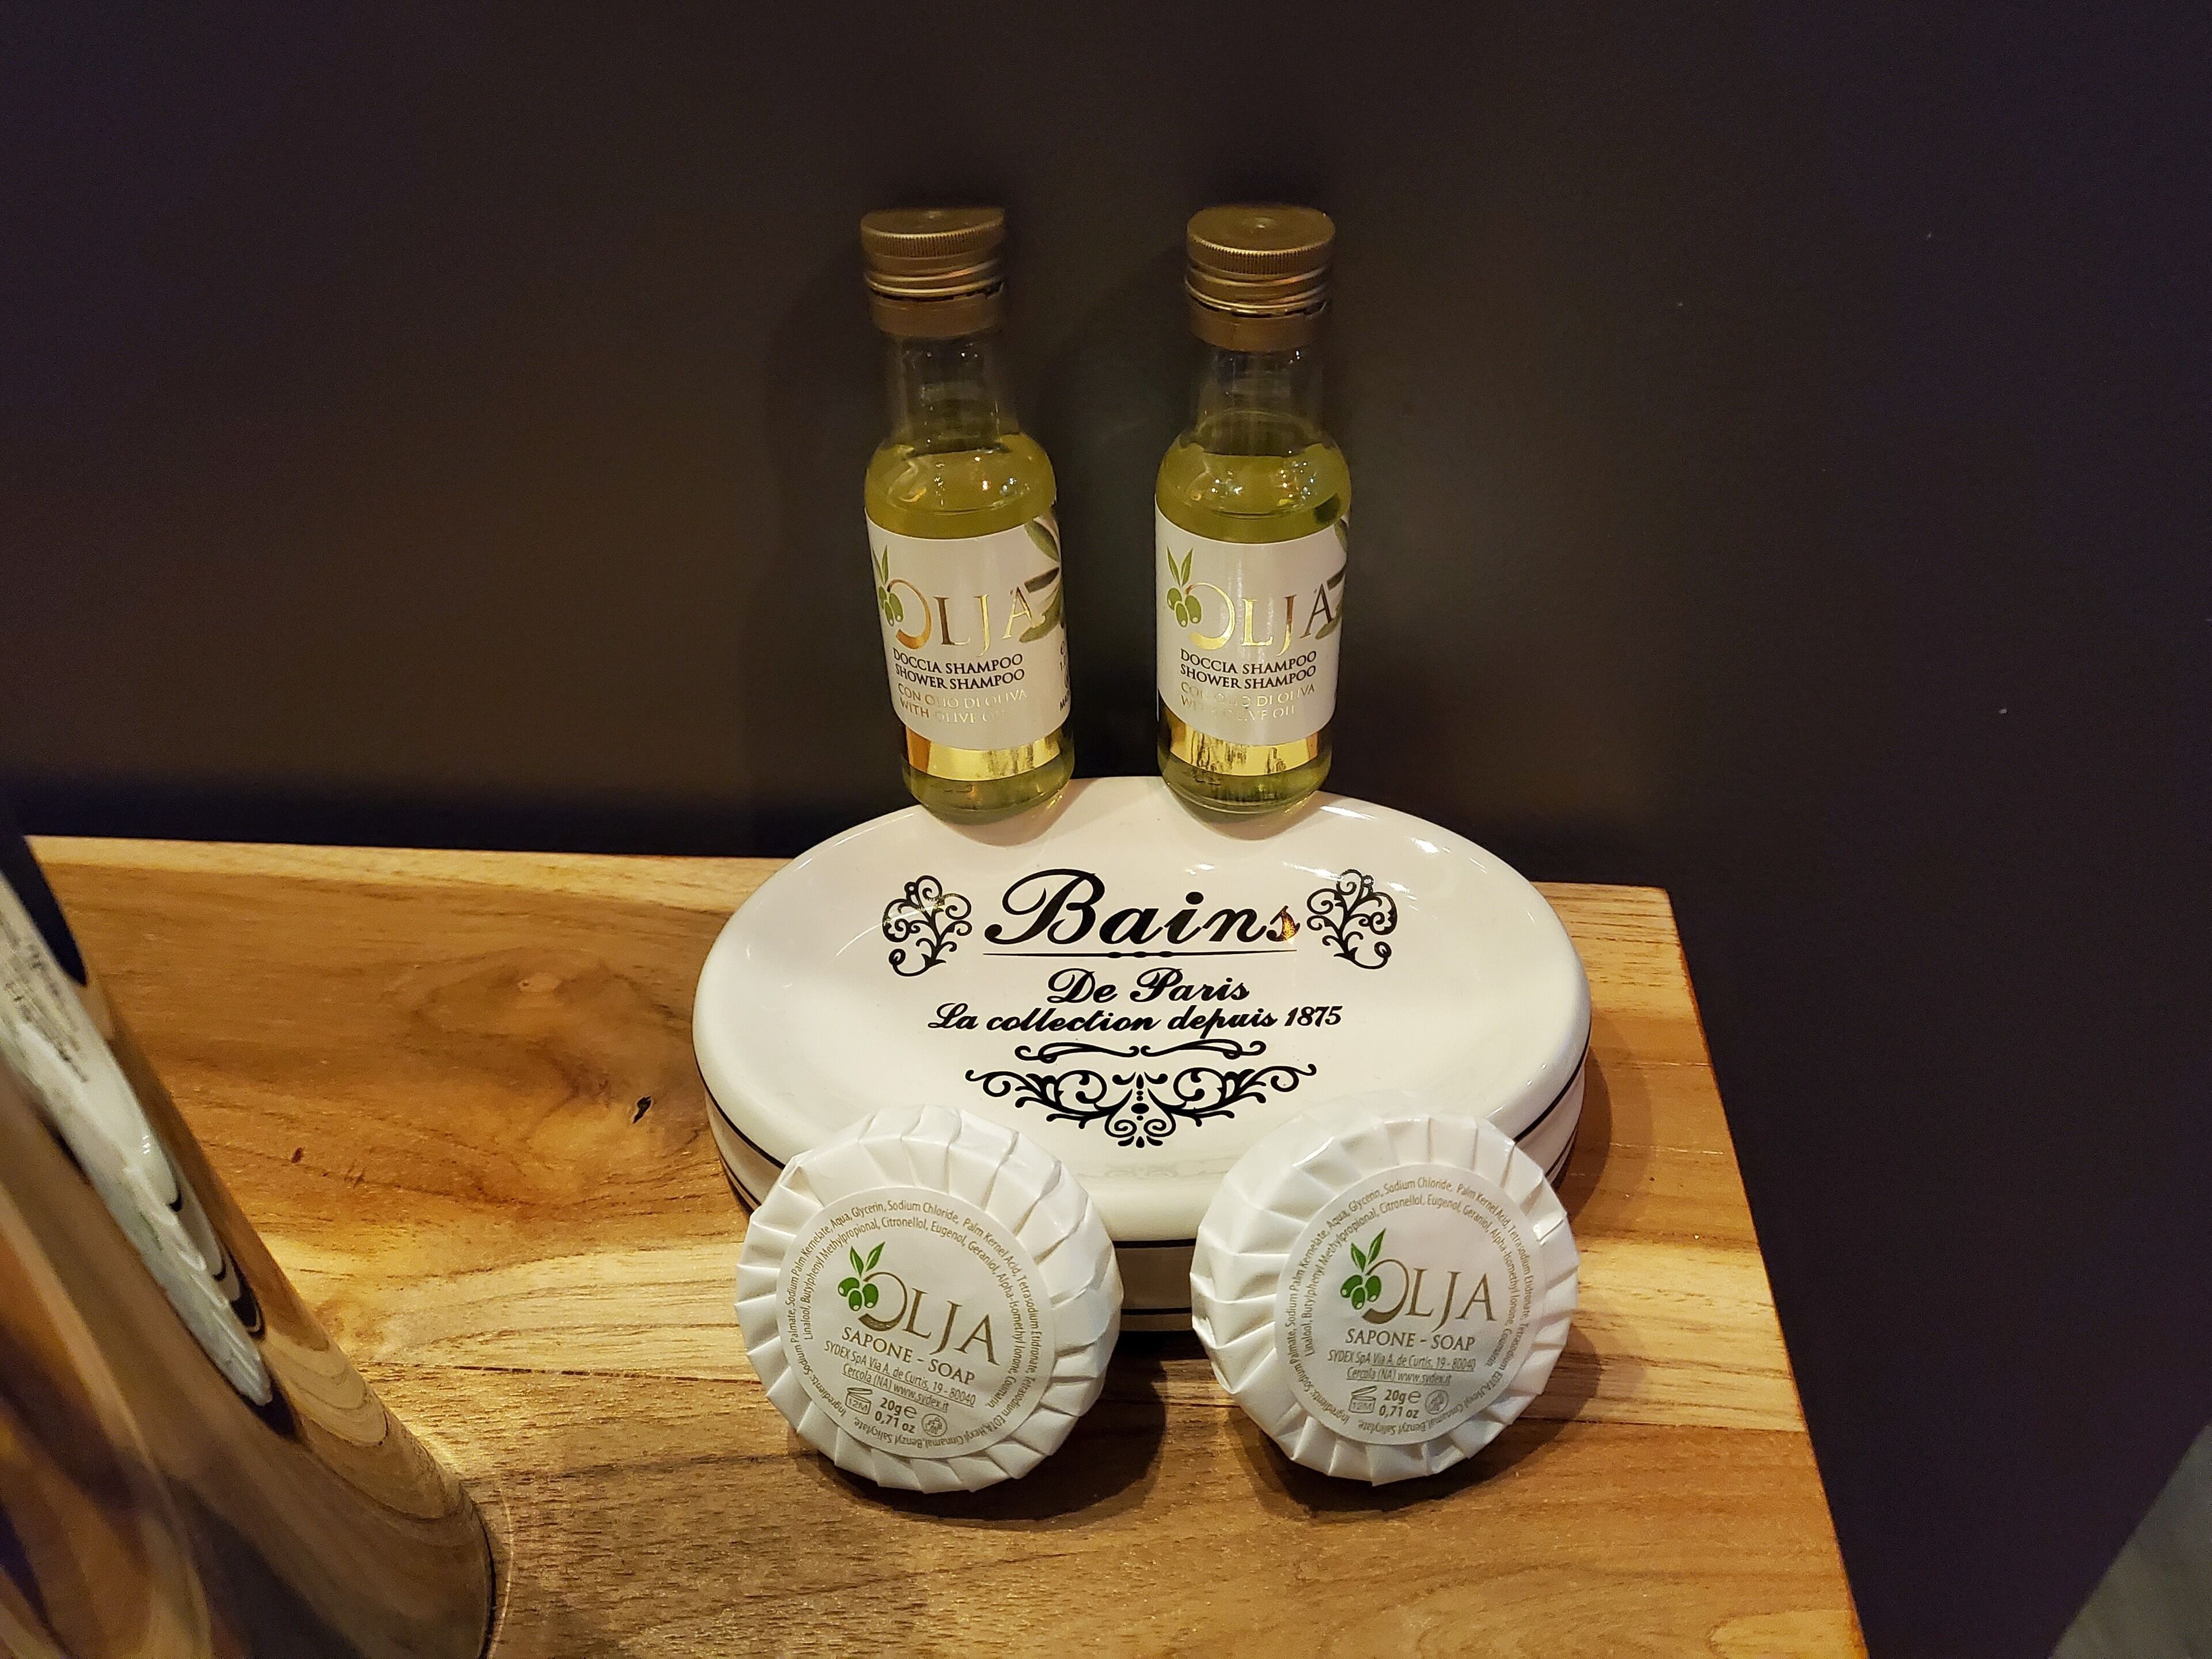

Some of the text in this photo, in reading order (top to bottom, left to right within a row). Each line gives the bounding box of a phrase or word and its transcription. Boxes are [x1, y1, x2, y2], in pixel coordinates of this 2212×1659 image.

[892, 647, 1023, 675] DOCCIA SHAMPOO
[1180, 648, 1317, 675] DOCCIA SHAMPOO
[895, 664, 1025, 690] SHOWER SHAMPOO
[1180, 665, 1316, 690] SHOWER SHAMPOO
[897, 683, 921, 702] CON
[964, 697, 980, 709] DI
[1256, 694, 1272, 707] DI
[1277, 683, 1315, 703] OLIVA
[899, 697, 930, 718] WITH
[935, 710, 976, 724] OLIVE
[984, 868, 1300, 946] Bains
[1047, 966, 1250, 1004] De Paris
[928, 1002, 1342, 1040] La collection depuis 1875
[1384, 1180, 1416, 1195] Sodium
[1417, 1176, 1453, 1192] Chloride,
[1456, 1183, 1476, 1199] Palm
[851, 1202, 887, 1217] Glycerin,
[888, 1200, 921, 1211] Sodium
[923, 1202, 959, 1224] Chloride,
[1348, 1189, 1384, 1213] Glycerin,
[1427, 1194, 1461, 1213] Eugenol,
[1475, 1194, 1499, 1215] Kernel
[830, 1212, 853, 1229] Aqua,
[881, 1217, 928, 1230] Citronellol,
[963, 1218, 984, 1237] Palm
[1326, 1210, 1351, 1230] Aqua,
[1462, 1205, 1493, 1233] Geraniol,
[1495, 1209, 1511, 1229] Acid,
[819, 1219, 880, 1260] Methylpropional,
[931, 1221, 969, 1247] Eugenol,
[983, 1232, 1009, 1257] Kernel
[1318, 1208, 1379, 1265] Methylpropional,
[968, 1241, 1000, 1275] Geraniol,
[1298, 1230, 1331, 1268] Kernelate,
[1508, 1225, 1531, 1275] Tetrasodium
[791, 1256, 807, 1278] Palm
[1005, 1255, 1022, 1277] Acid,
[785, 1276, 798, 1307] Sodium
[800, 1256, 824, 1304] Butylphenyl
[1289, 1270, 1305, 1292] Palm
[1301, 1261, 1325, 1319] Butylphenyl
[1017, 1275, 1039, 1330] Tetrasodium
[1362, 1259, 1497, 1332] OLJA
[800, 1304, 813, 1340] Linalool,
[858, 1272, 999, 1366] OLJA
[1286, 1293, 1297, 1327] Sodium
[787, 1308, 799, 1343] Palmate,
[1301, 1320, 1315, 1357] Linalool,
[1287, 1328, 1298, 1364] Palmate,
[1345, 1328, 1416, 1347] SAPONE
[1430, 1334, 1475, 1351] SOAP
[794, 1344, 813, 1375] Sodium
[824, 1340, 850, 1359] SYDEX
[852, 1352, 866, 1366] SpA
[869, 1357, 881, 1370] Via
[893, 1368, 903, 1378] de
[905, 1371, 929, 1390] Curtis,
[934, 1381, 943, 1393] 19
[842, 1327, 912, 1363] SAPONE
[928, 1358, 975, 1384] SOAP
[1327, 1349, 1354, 1362] SYDEX
[1355, 1353, 1371, 1366] SpA
[1372, 1354, 1385, 1365] Via
[1396, 1356, 1407, 1366] de
[1437, 1357, 1446, 1368] 19
[843, 1363, 872, 1382] Cercola
[874, 1374, 892, 1390] (NA)
[1294, 1364, 1312, 1392] Sodium
[1347, 1366, 1376, 1380] Cercola
[1378, 1368, 1396, 1382] (NA)
[811, 1374, 846, 1417] Ingredients:
[875, 1411, 916, 1434] 0,71 oz
[1379, 1405, 1419, 1419] 0,71 oz
